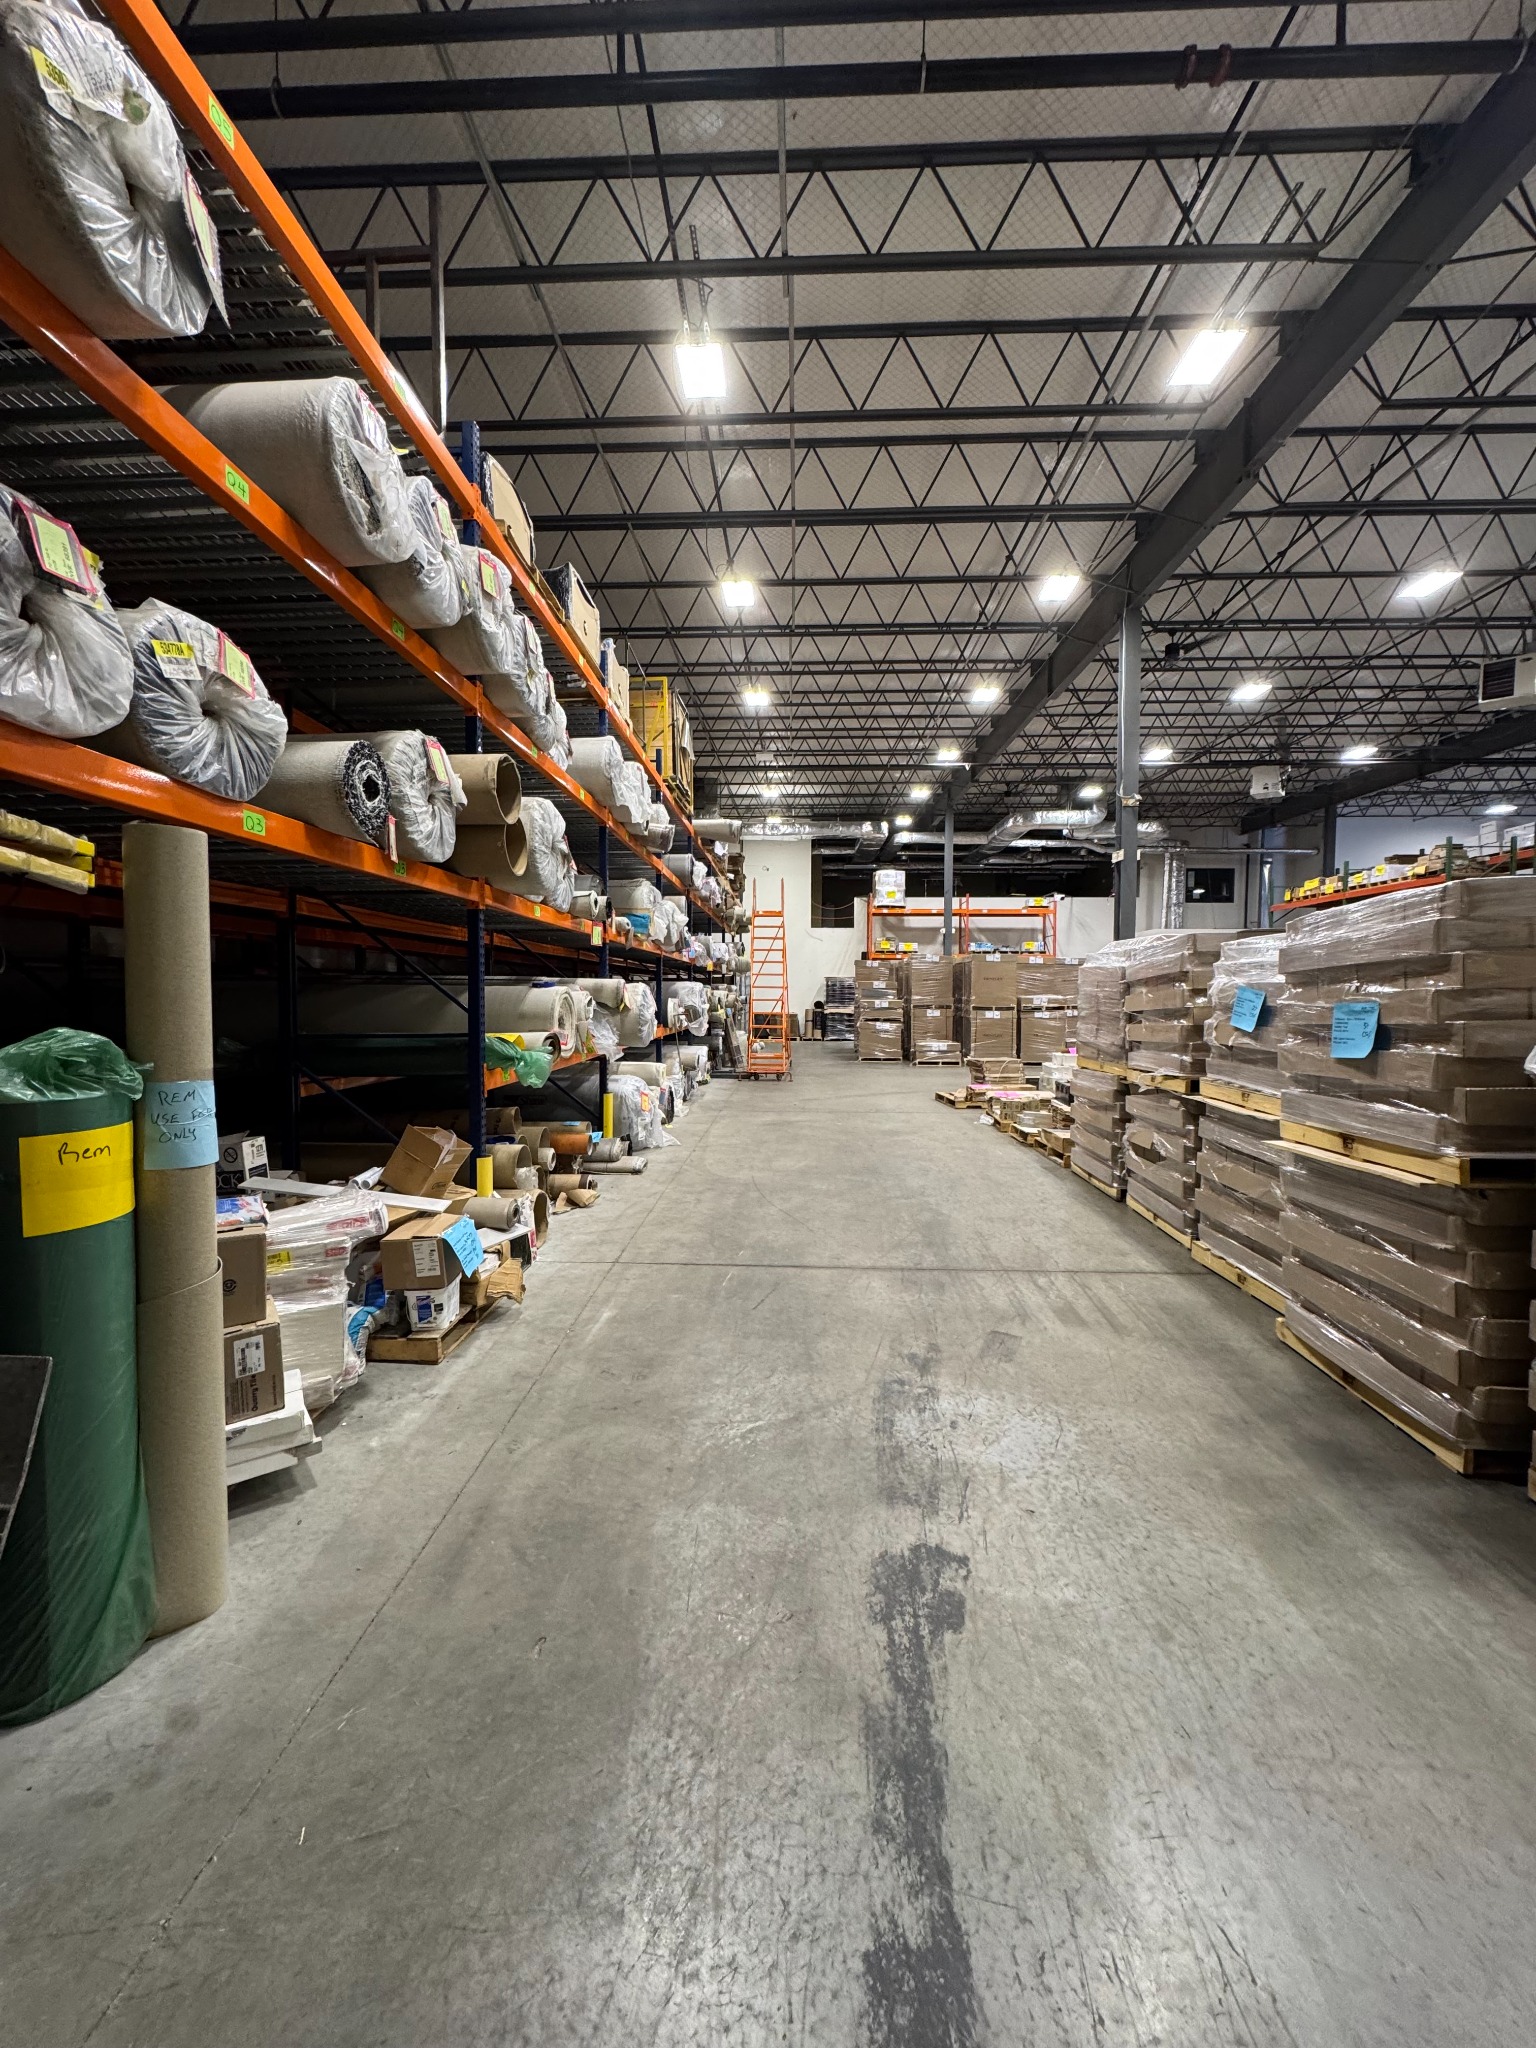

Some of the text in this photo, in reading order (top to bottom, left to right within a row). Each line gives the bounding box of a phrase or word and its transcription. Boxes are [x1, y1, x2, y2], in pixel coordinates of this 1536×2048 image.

[227, 471, 246, 498] Q4
[245, 815, 264, 833] Q3
[158, 1089, 196, 1106] REM
[150, 1107, 212, 1126] USE FOR
[158, 1127, 197, 1143] ONLY
[58, 1142, 111, 1165] Rem
